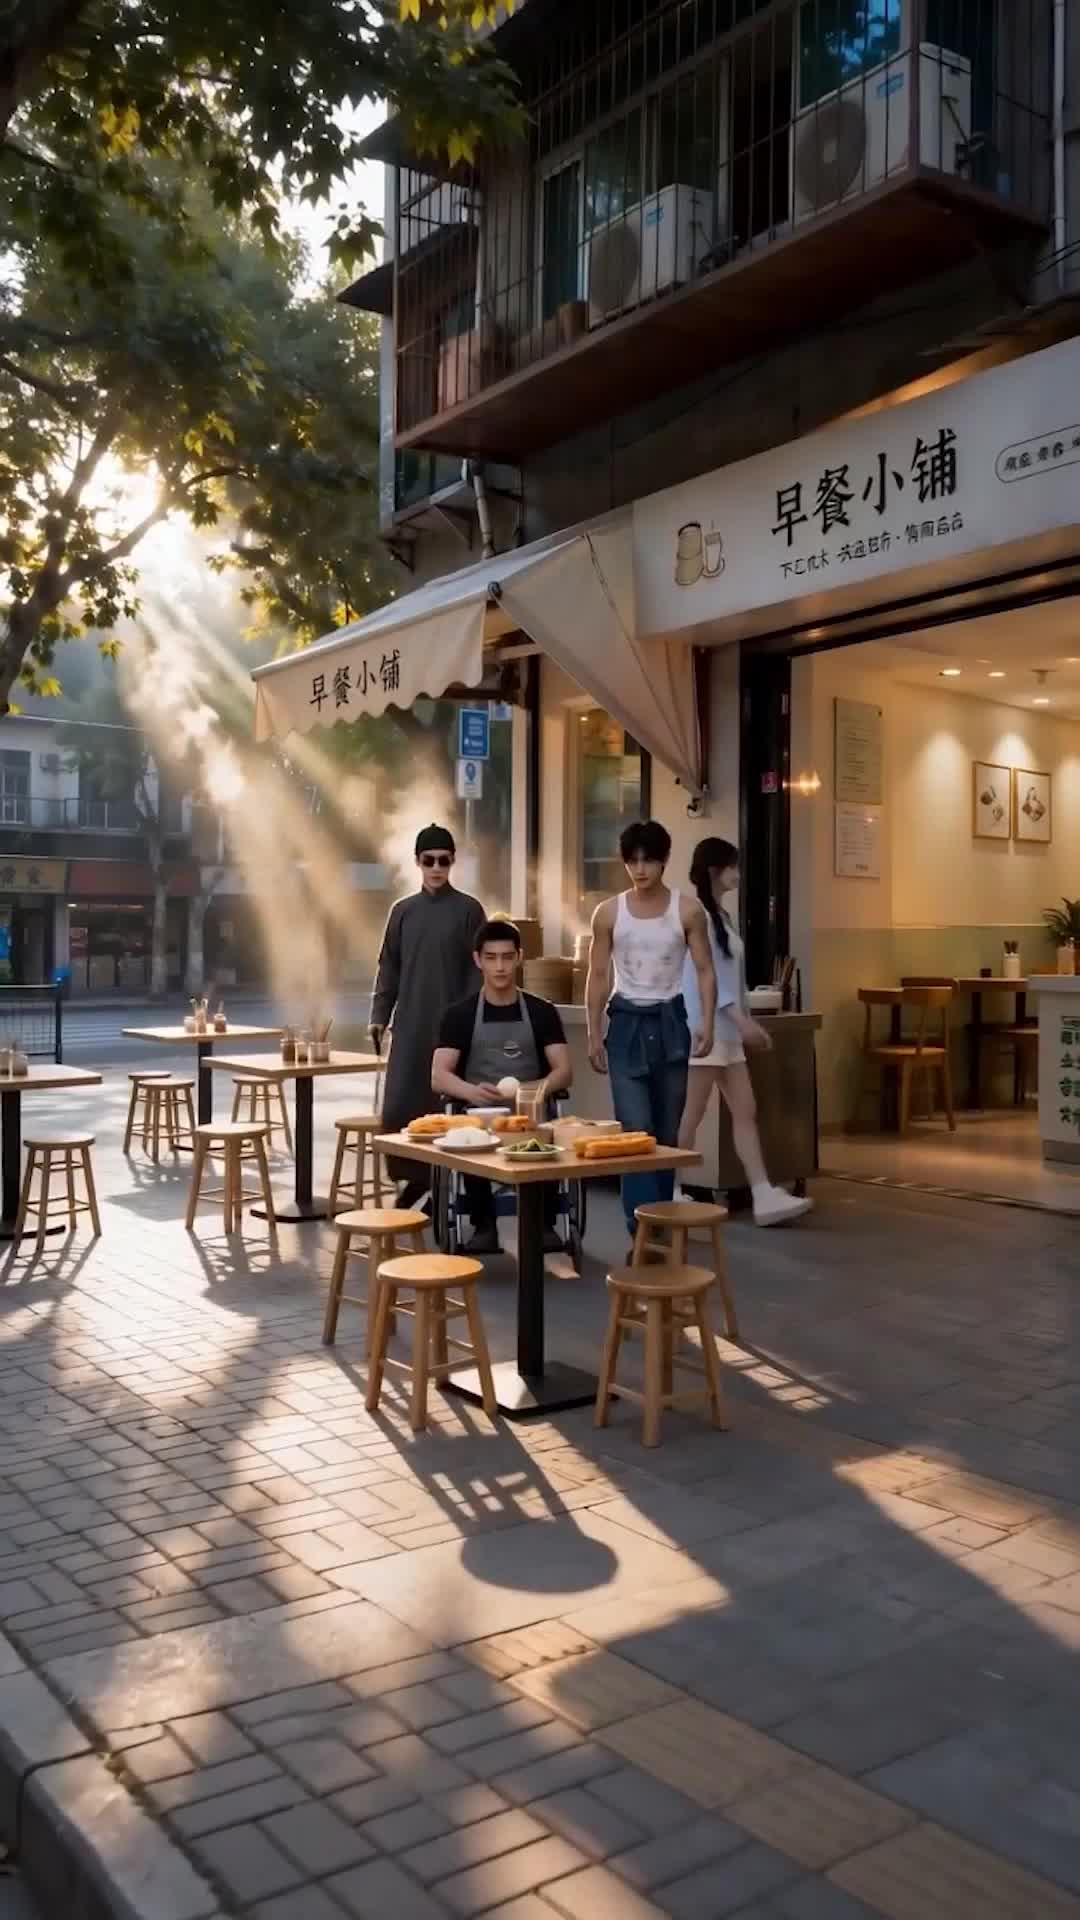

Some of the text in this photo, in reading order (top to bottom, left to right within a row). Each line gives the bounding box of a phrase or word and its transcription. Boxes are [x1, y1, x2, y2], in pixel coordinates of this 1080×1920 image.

[771, 428, 957, 547] 早餐小铺
[310, 648, 400, 712] 早餐小铺
